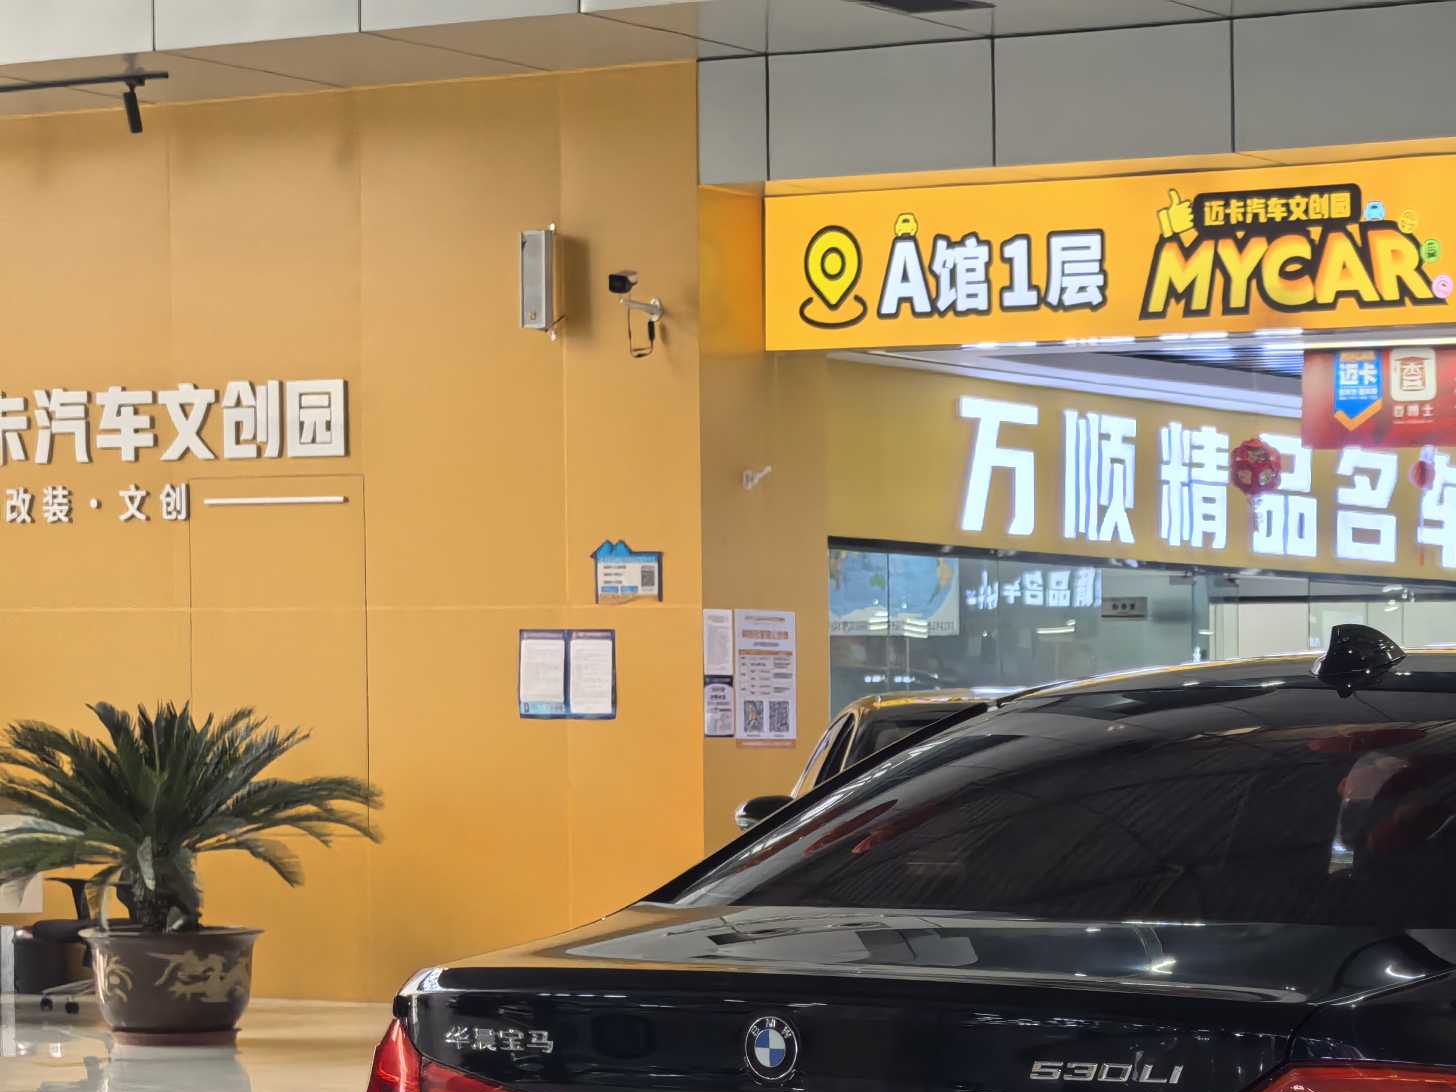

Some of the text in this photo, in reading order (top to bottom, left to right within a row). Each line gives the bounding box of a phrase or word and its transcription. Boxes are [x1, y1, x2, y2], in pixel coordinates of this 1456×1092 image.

[1203, 192, 1352, 227] 迈卡汽车文创园
[879, 232, 1106, 318] A馆1层
[1147, 228, 1436, 314] MYCAR
[445, 1025, 554, 1054] 华晨宝马
